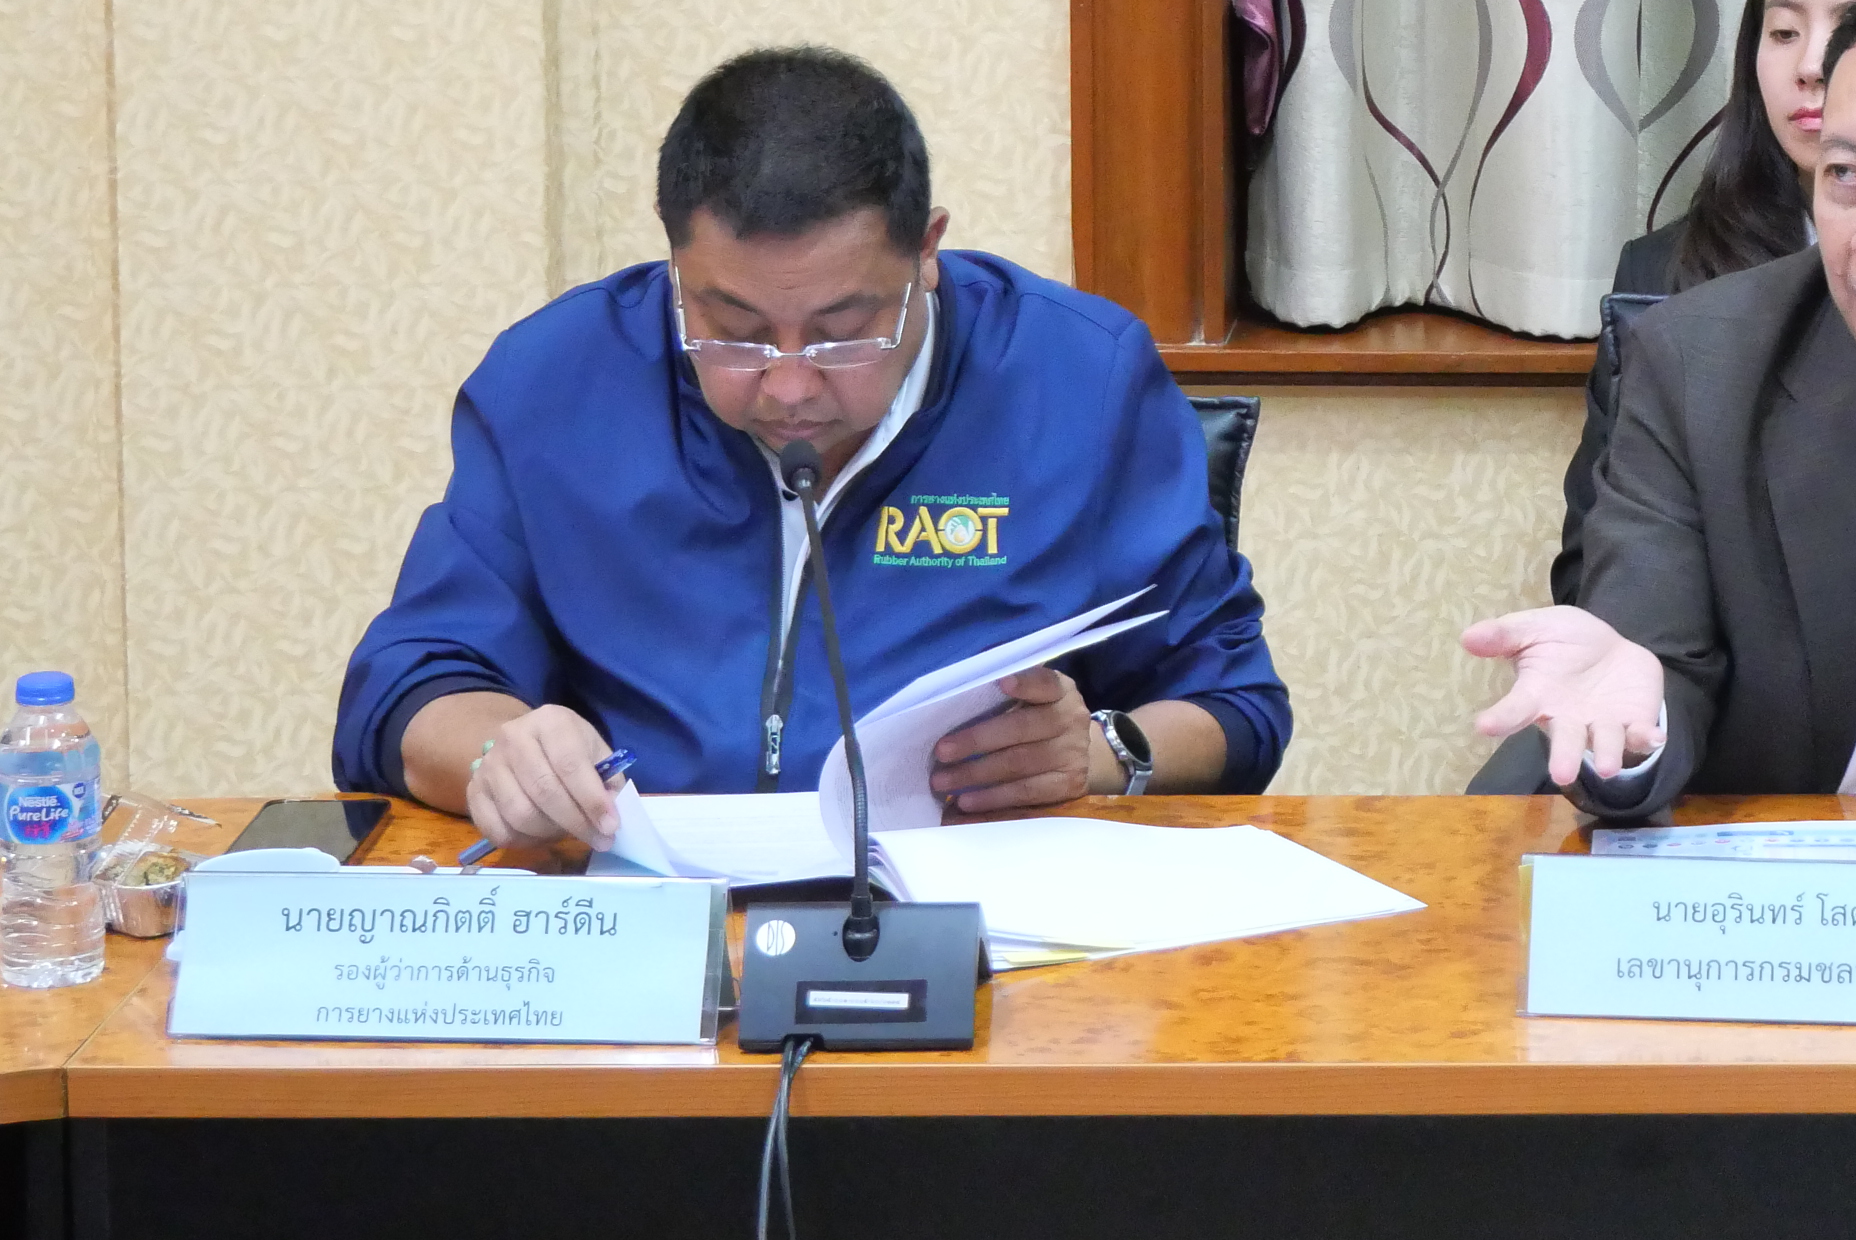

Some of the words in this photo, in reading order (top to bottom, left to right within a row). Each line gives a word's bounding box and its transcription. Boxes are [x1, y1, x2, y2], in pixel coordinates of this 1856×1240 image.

[875, 506, 1010, 554] RAOT
[873, 554, 909, 566] Rubber
[909, 555, 953, 568] Authority
[955, 555, 965, 566] of
[967, 555, 1007, 566] Thailand
[280, 884, 501, 945] นายญาณกิตติ์
[512, 895, 618, 937] ฮาร์ดีน
[1652, 891, 1806, 936] นายอุรินทร์
[333, 954, 556, 992] รองผู้ว่าการด้านธุรกิจ
[316, 999, 564, 1027] การยางแห่งประเทศไทย
